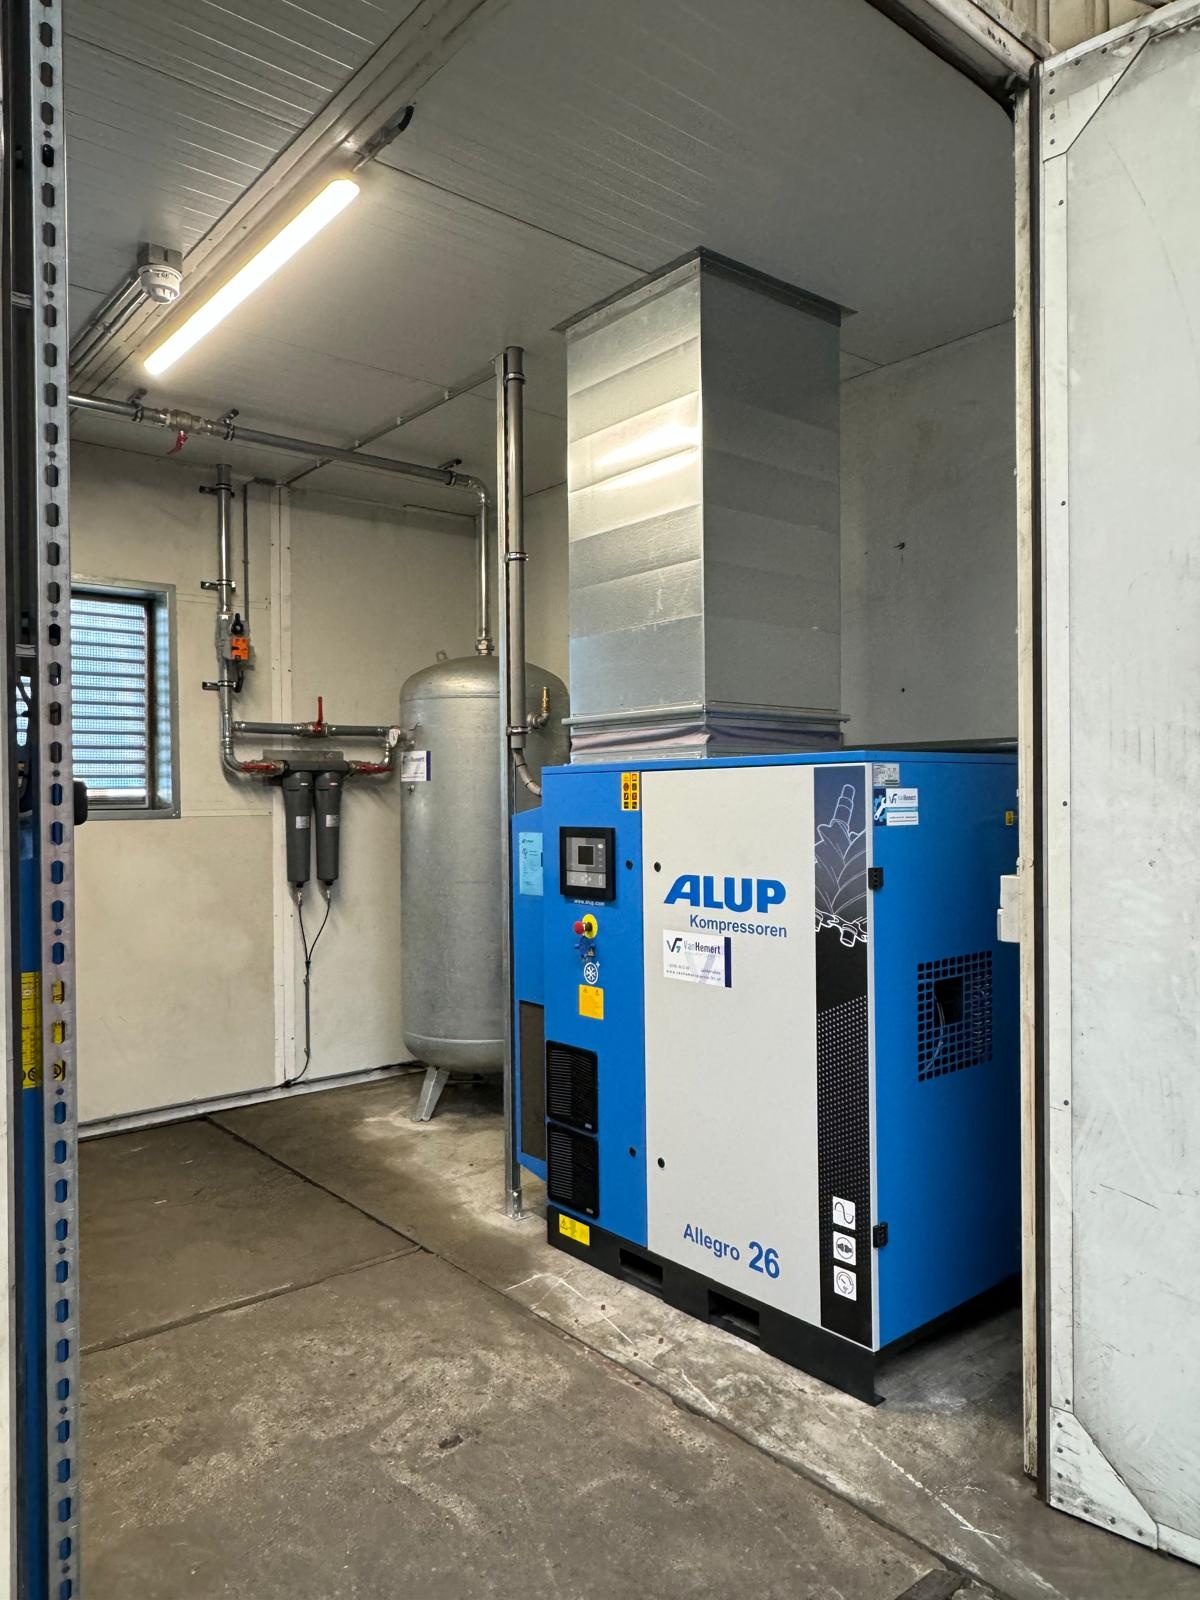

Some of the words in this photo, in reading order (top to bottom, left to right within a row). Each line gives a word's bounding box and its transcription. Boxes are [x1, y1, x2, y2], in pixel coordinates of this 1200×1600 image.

[663, 874, 787, 914] ALUP
[690, 914, 788, 938] Kompressoren
[683, 1223, 741, 1261] Allegro
[748, 1241, 780, 1279] 26
